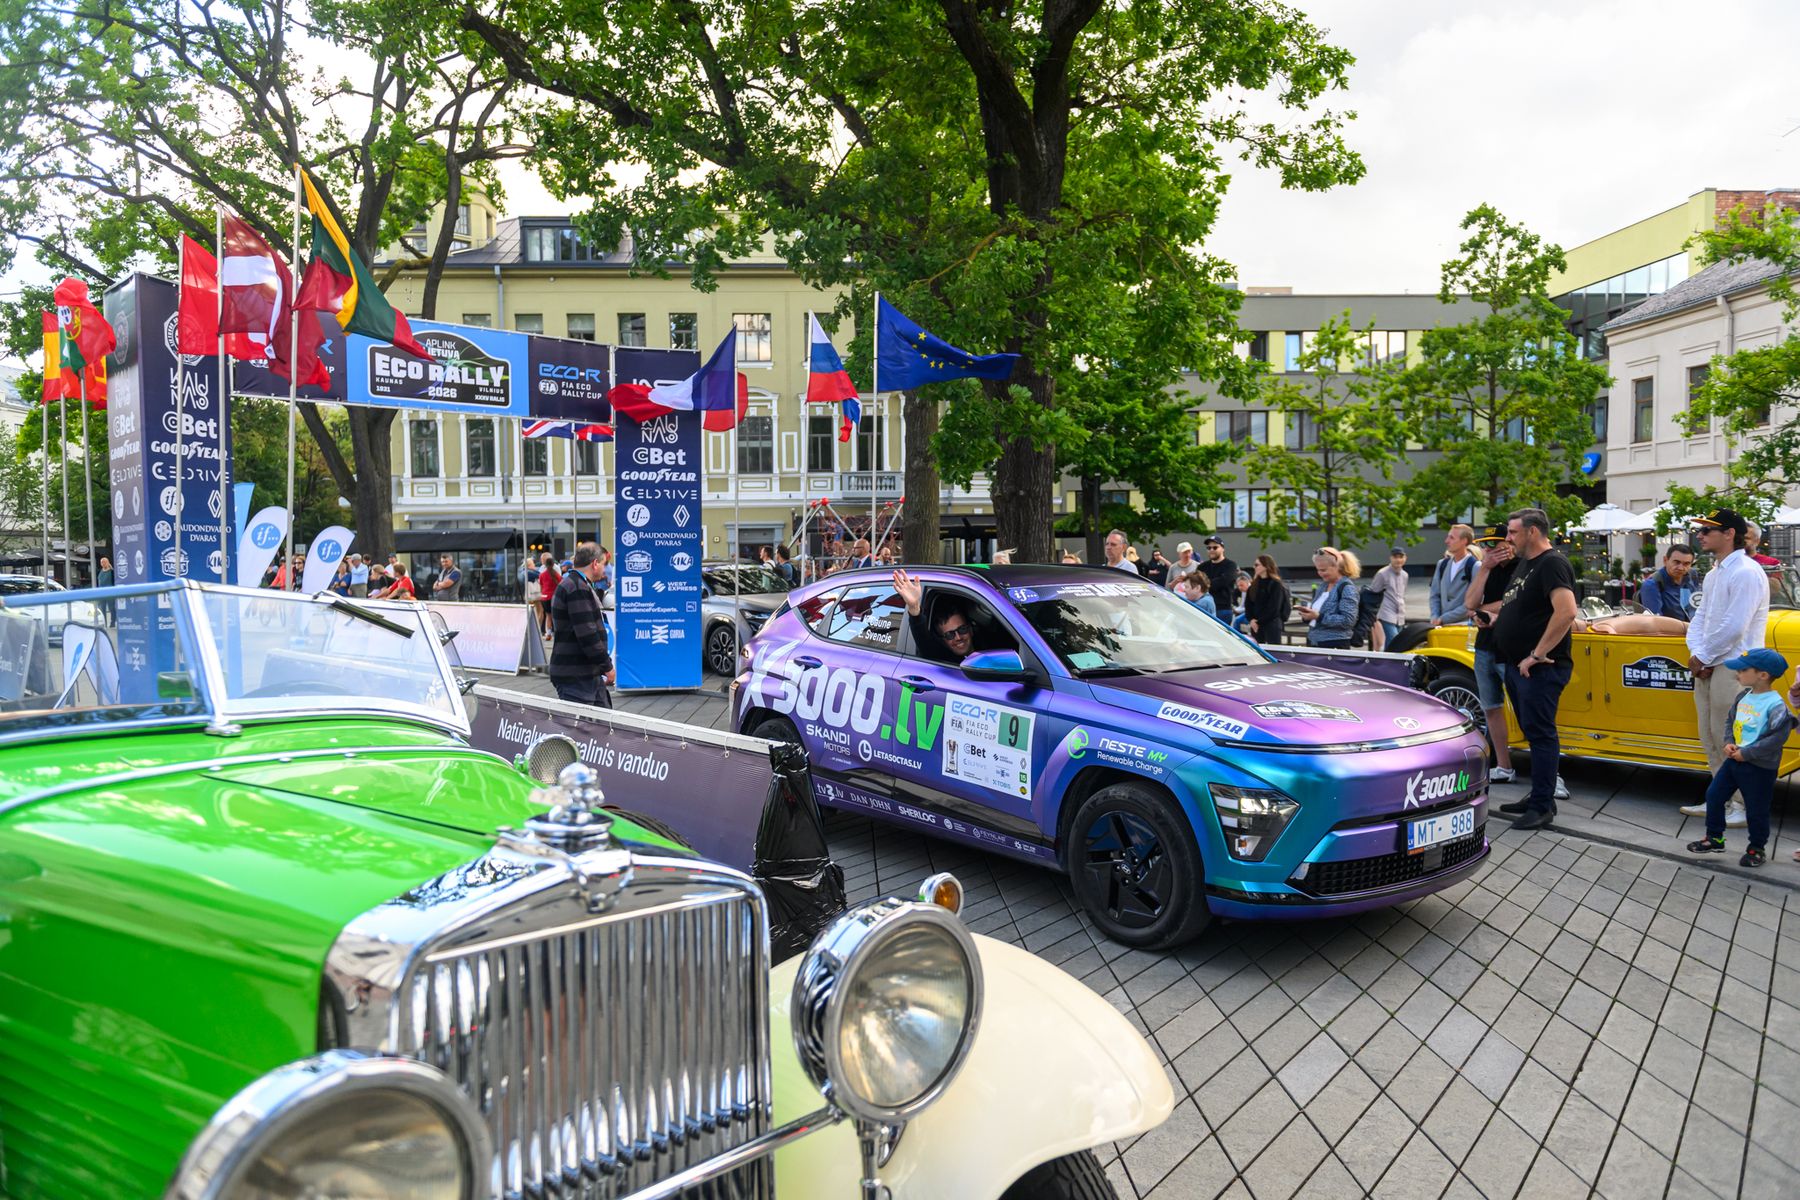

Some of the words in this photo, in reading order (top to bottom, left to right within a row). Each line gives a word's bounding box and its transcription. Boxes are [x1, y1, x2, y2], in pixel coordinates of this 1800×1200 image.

[425, 338, 457, 350] APLINK
[375, 352, 424, 380] ECO
[428, 362, 505, 388] RALLY
[375, 376, 403, 386] KAUNAS
[561, 381, 575, 390] FIA
[576, 383, 592, 391] ECO
[428, 386, 458, 399] 2026
[478, 386, 505, 395] VILNIUS
[561, 389, 585, 399] RALLY
[586, 392, 602, 400] CUP
[621, 469, 697, 484] GOODYEAR
[190, 534, 217, 542] DVARAS
[639, 531, 698, 540] RAUDONDVARIO
[655, 539, 682, 547] DVARAS
[670, 556, 694, 567] KIKA
[624, 581, 639, 592] 15
[865, 629, 892, 644] Svencis
[1204, 671, 1347, 692] SKANDI
[1625, 667, 1649, 679] ECO
[1650, 670, 1693, 682] RALLY
[738, 640, 945, 751] X3000.lv
[976, 722, 989, 731] ECO
[1161, 705, 1244, 736] GOODYEAR
[806, 723, 851, 746] SKANDI
[965, 728, 983, 738] RALLY
[984, 731, 996, 741] CUP
[1008, 715, 1020, 748] 9
[823, 741, 851, 756] MOTORS
[873, 749, 923, 770] LETASOCTAS.LV
[1097, 751, 1135, 768] Renewable
[1135, 763, 1163, 776] Charge
[1147, 750, 1169, 763] MY
[617, 751, 669, 781] vanduo
[1403, 770, 1470, 810] X3000.lv
[850, 793, 868, 805] DAN
[870, 797, 892, 812] JOHN
[898, 806, 936, 824] SHERLOG
[1418, 820, 1436, 845] MT
[1451, 811, 1472, 836] 988
